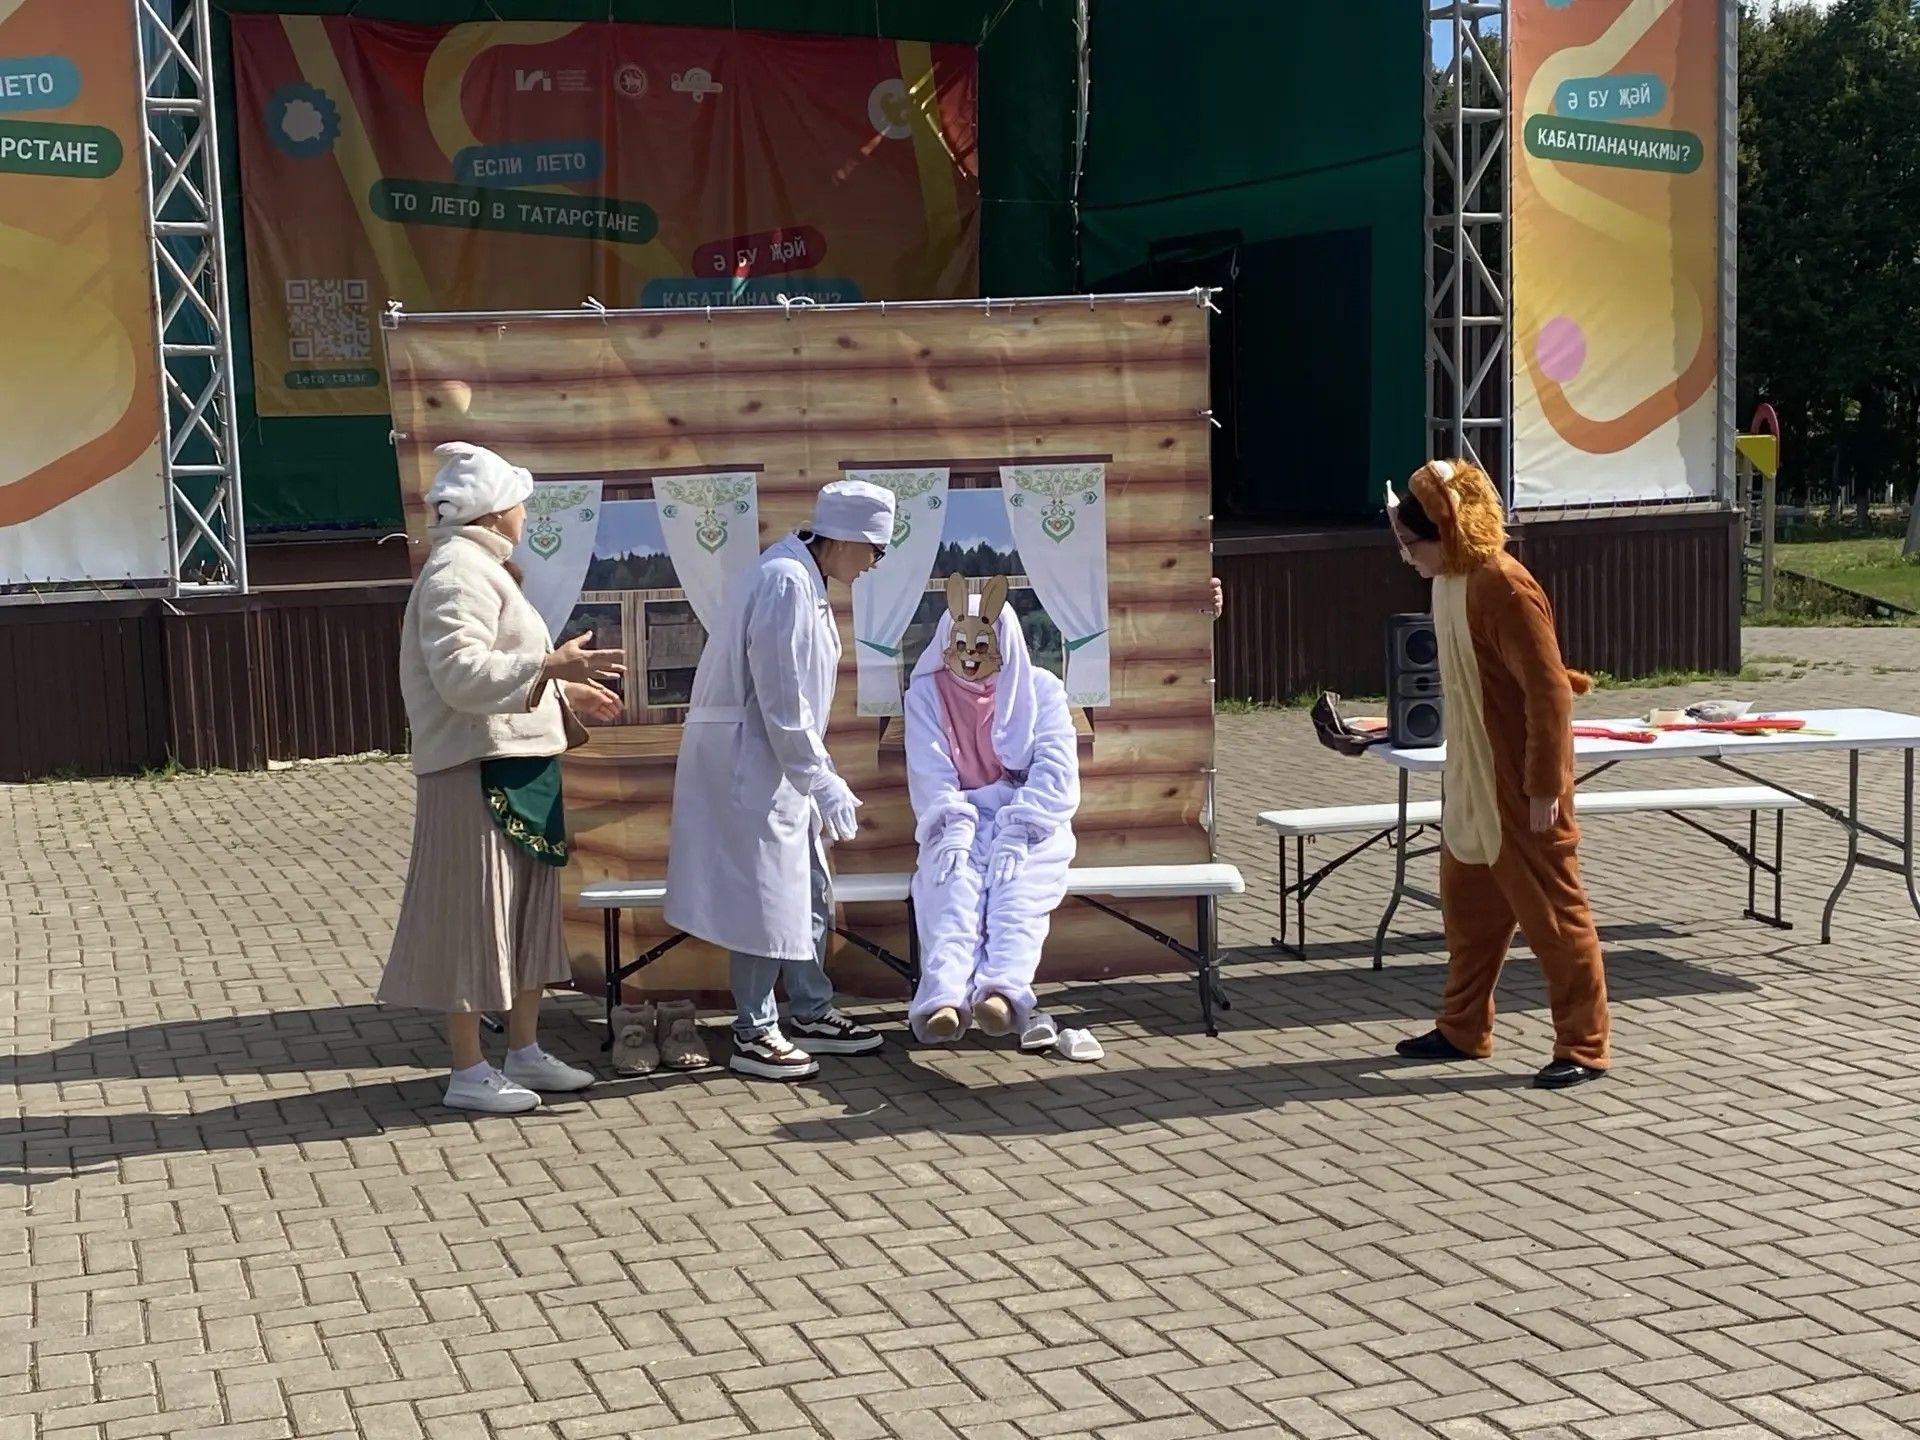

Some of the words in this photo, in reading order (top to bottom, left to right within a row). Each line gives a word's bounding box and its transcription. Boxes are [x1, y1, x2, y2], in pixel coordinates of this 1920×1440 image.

[1568, 92, 1578, 110] Ә
[1588, 90, 1609, 108] БУ
[1619, 83, 1651, 109] ҖӘЙ
[1, 137, 99, 164] РСТАНЕ
[1537, 127, 1691, 162] КАБАТЛАНАЧАКМЫ?
[473, 157, 523, 177] ЕСЛИ
[536, 152, 586, 172] ЛЕТО
[390, 192, 418, 211] ТО
[430, 196, 480, 217] ЛЕТО
[493, 203, 505, 220] В
[517, 204, 640, 233] ТАТАРСТАНЕ
[713, 254, 726, 271] Ә
[737, 248, 757, 267] БУ
[771, 236, 807, 264] ҖӘЙ
[662, 291, 842, 307] КАБАТЛАНАЫ?
